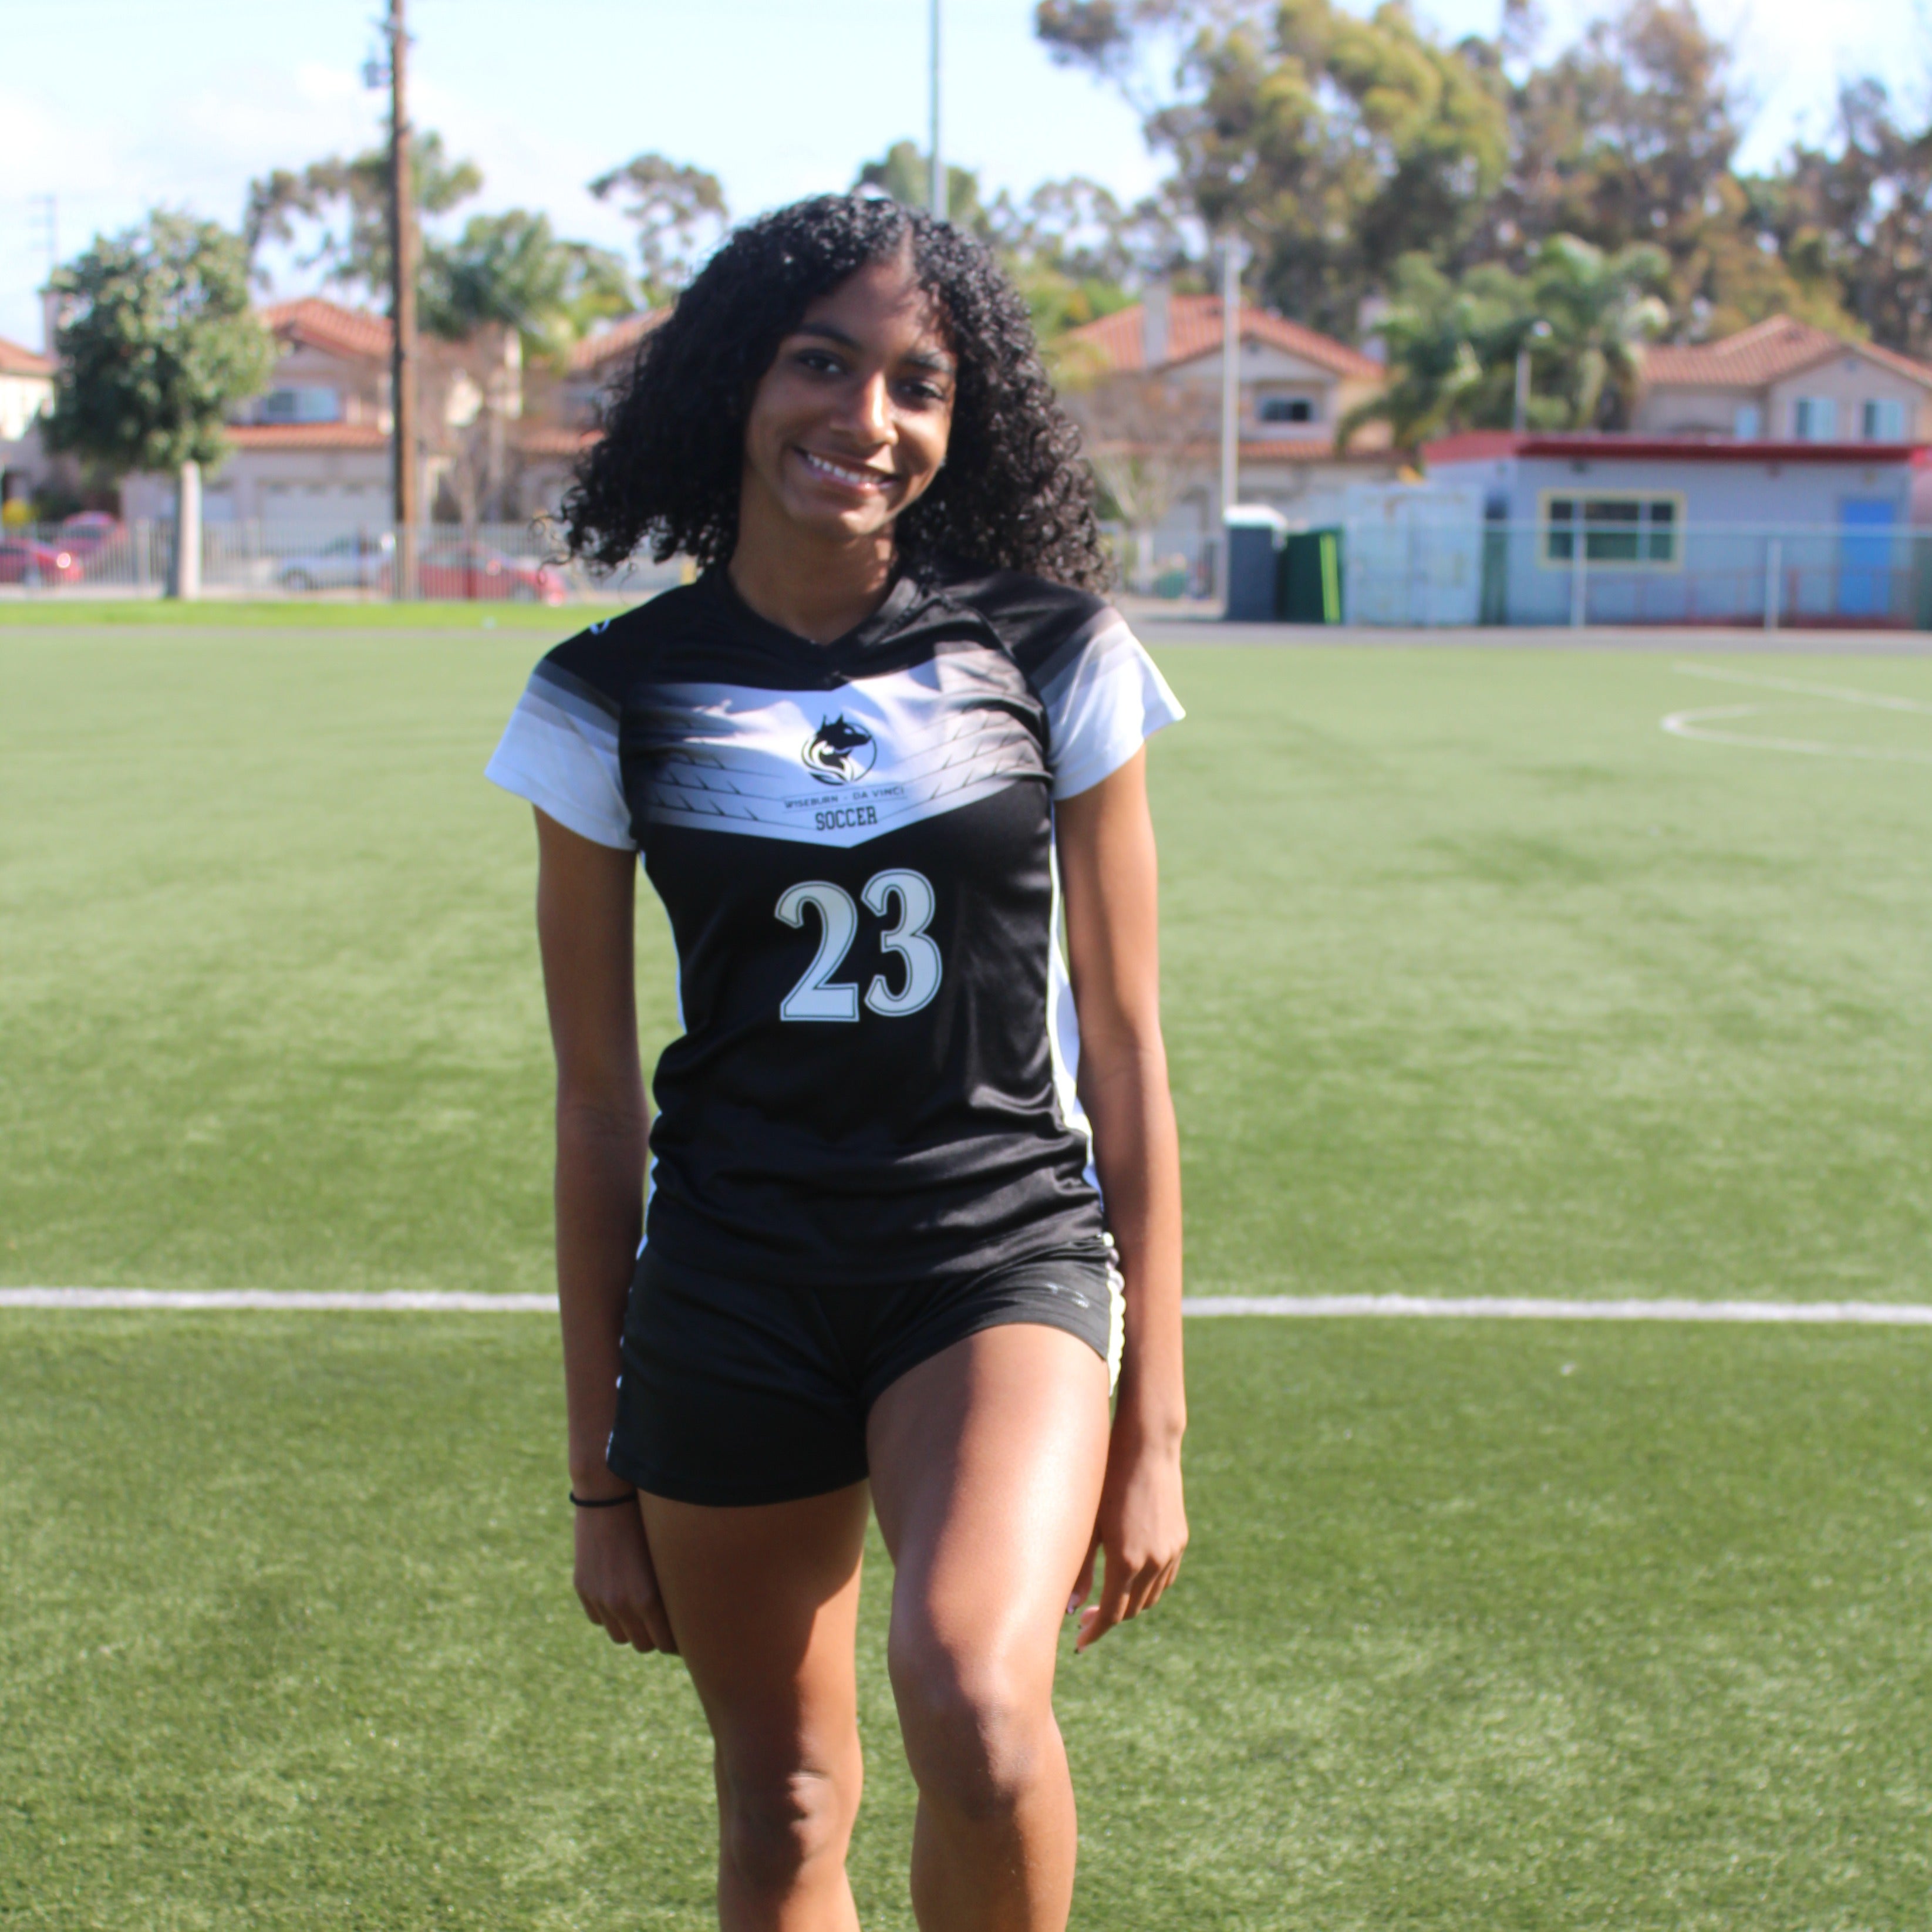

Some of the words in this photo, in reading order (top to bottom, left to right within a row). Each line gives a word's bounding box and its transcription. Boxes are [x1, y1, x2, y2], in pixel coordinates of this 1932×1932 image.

[784, 795, 838, 808] WISEBURN
[853, 791, 868, 800] DA
[872, 786, 904, 797] VINCI
[815, 805, 878, 831] SOCCER
[774, 868, 943, 1022] 23
